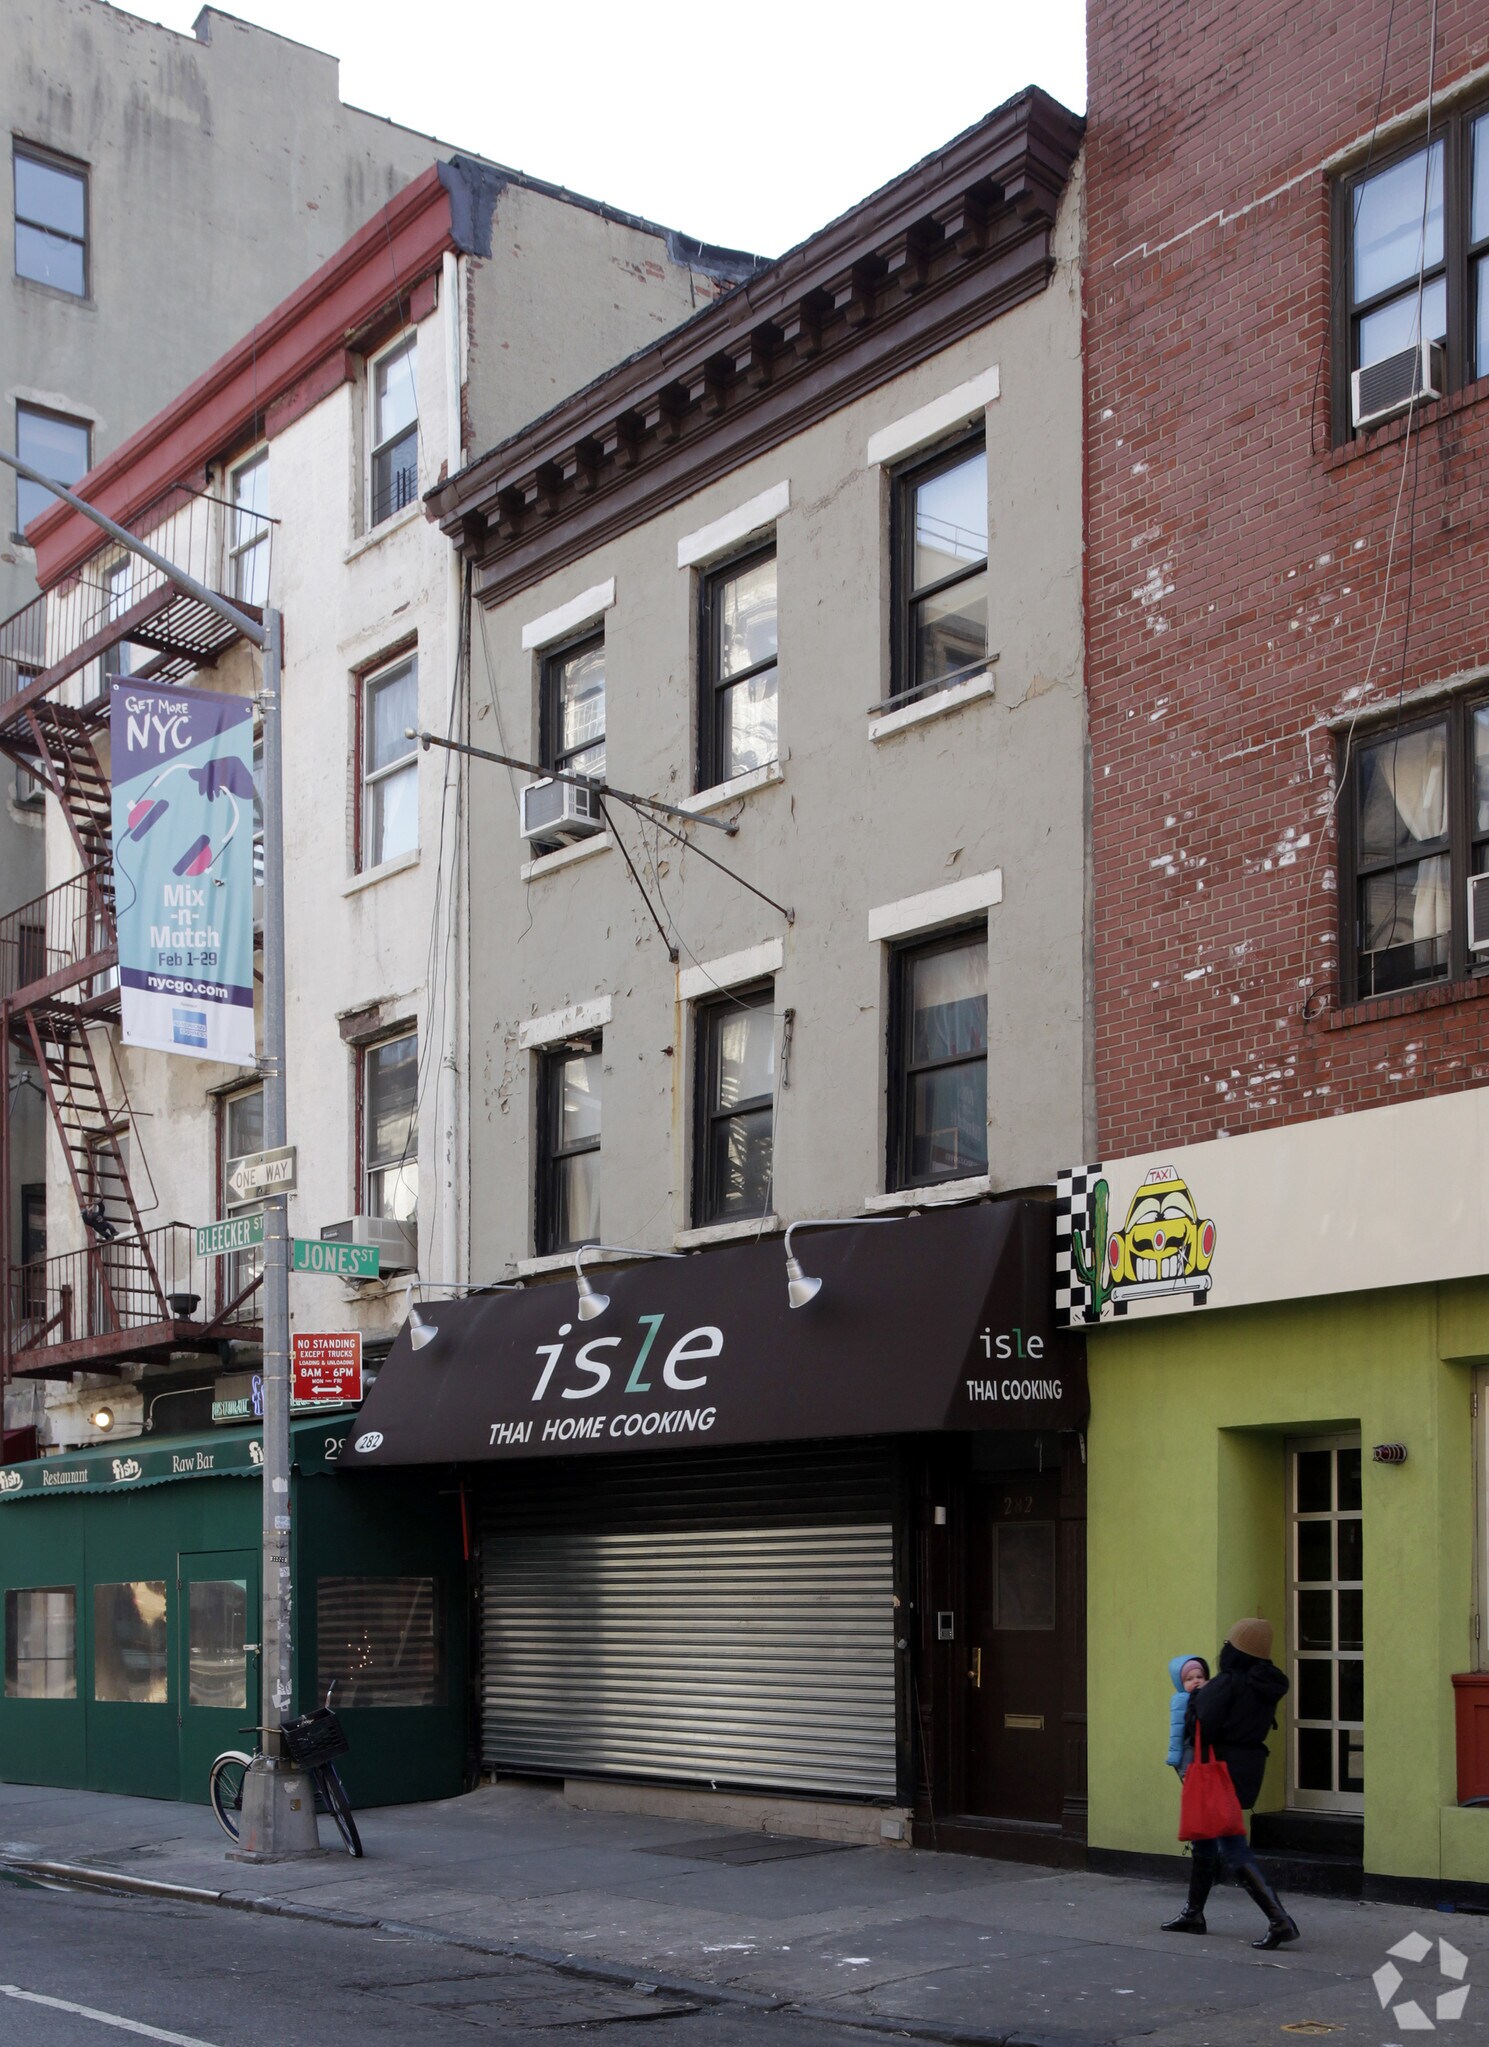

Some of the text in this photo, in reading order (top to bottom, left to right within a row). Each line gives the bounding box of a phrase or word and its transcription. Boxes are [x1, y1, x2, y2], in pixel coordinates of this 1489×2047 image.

[125, 696, 189, 715] GET MORE
[127, 713, 192, 753] NYC
[163, 884, 205, 907] Mix
[170, 908, 200, 926] -n-
[150, 925, 221, 948] Match
[158, 952, 183, 967] Feb
[147, 976, 229, 999] nycgo.com
[236, 1161, 288, 1188] ONE WAY
[1149, 1168, 1172, 1182] TAXI
[199, 1216, 264, 1254] BLEECKER ST
[299, 1243, 375, 1274] JONES ST
[297, 1339, 356, 1349] NO STANDING
[300, 1350, 353, 1358] EXCEPT TRUCKS
[979, 1327, 1044, 1359] isle
[531, 1313, 724, 1401] isle
[300, 1368, 322, 1377] 8AM
[332, 1367, 354, 1377] 6PM
[966, 1379, 1063, 1401] THAI COOKING
[489, 1406, 717, 1445] THAI HOME COOKING
[359, 1434, 381, 1449] 282
[42, 1468, 89, 1487] Restaurant
[112, 1458, 139, 1480] fish
[172, 1455, 195, 1473] Raw
[196, 1452, 215, 1470] Bar
[249, 1440, 265, 1464] fi
[1003, 1495, 1033, 1515] 282
